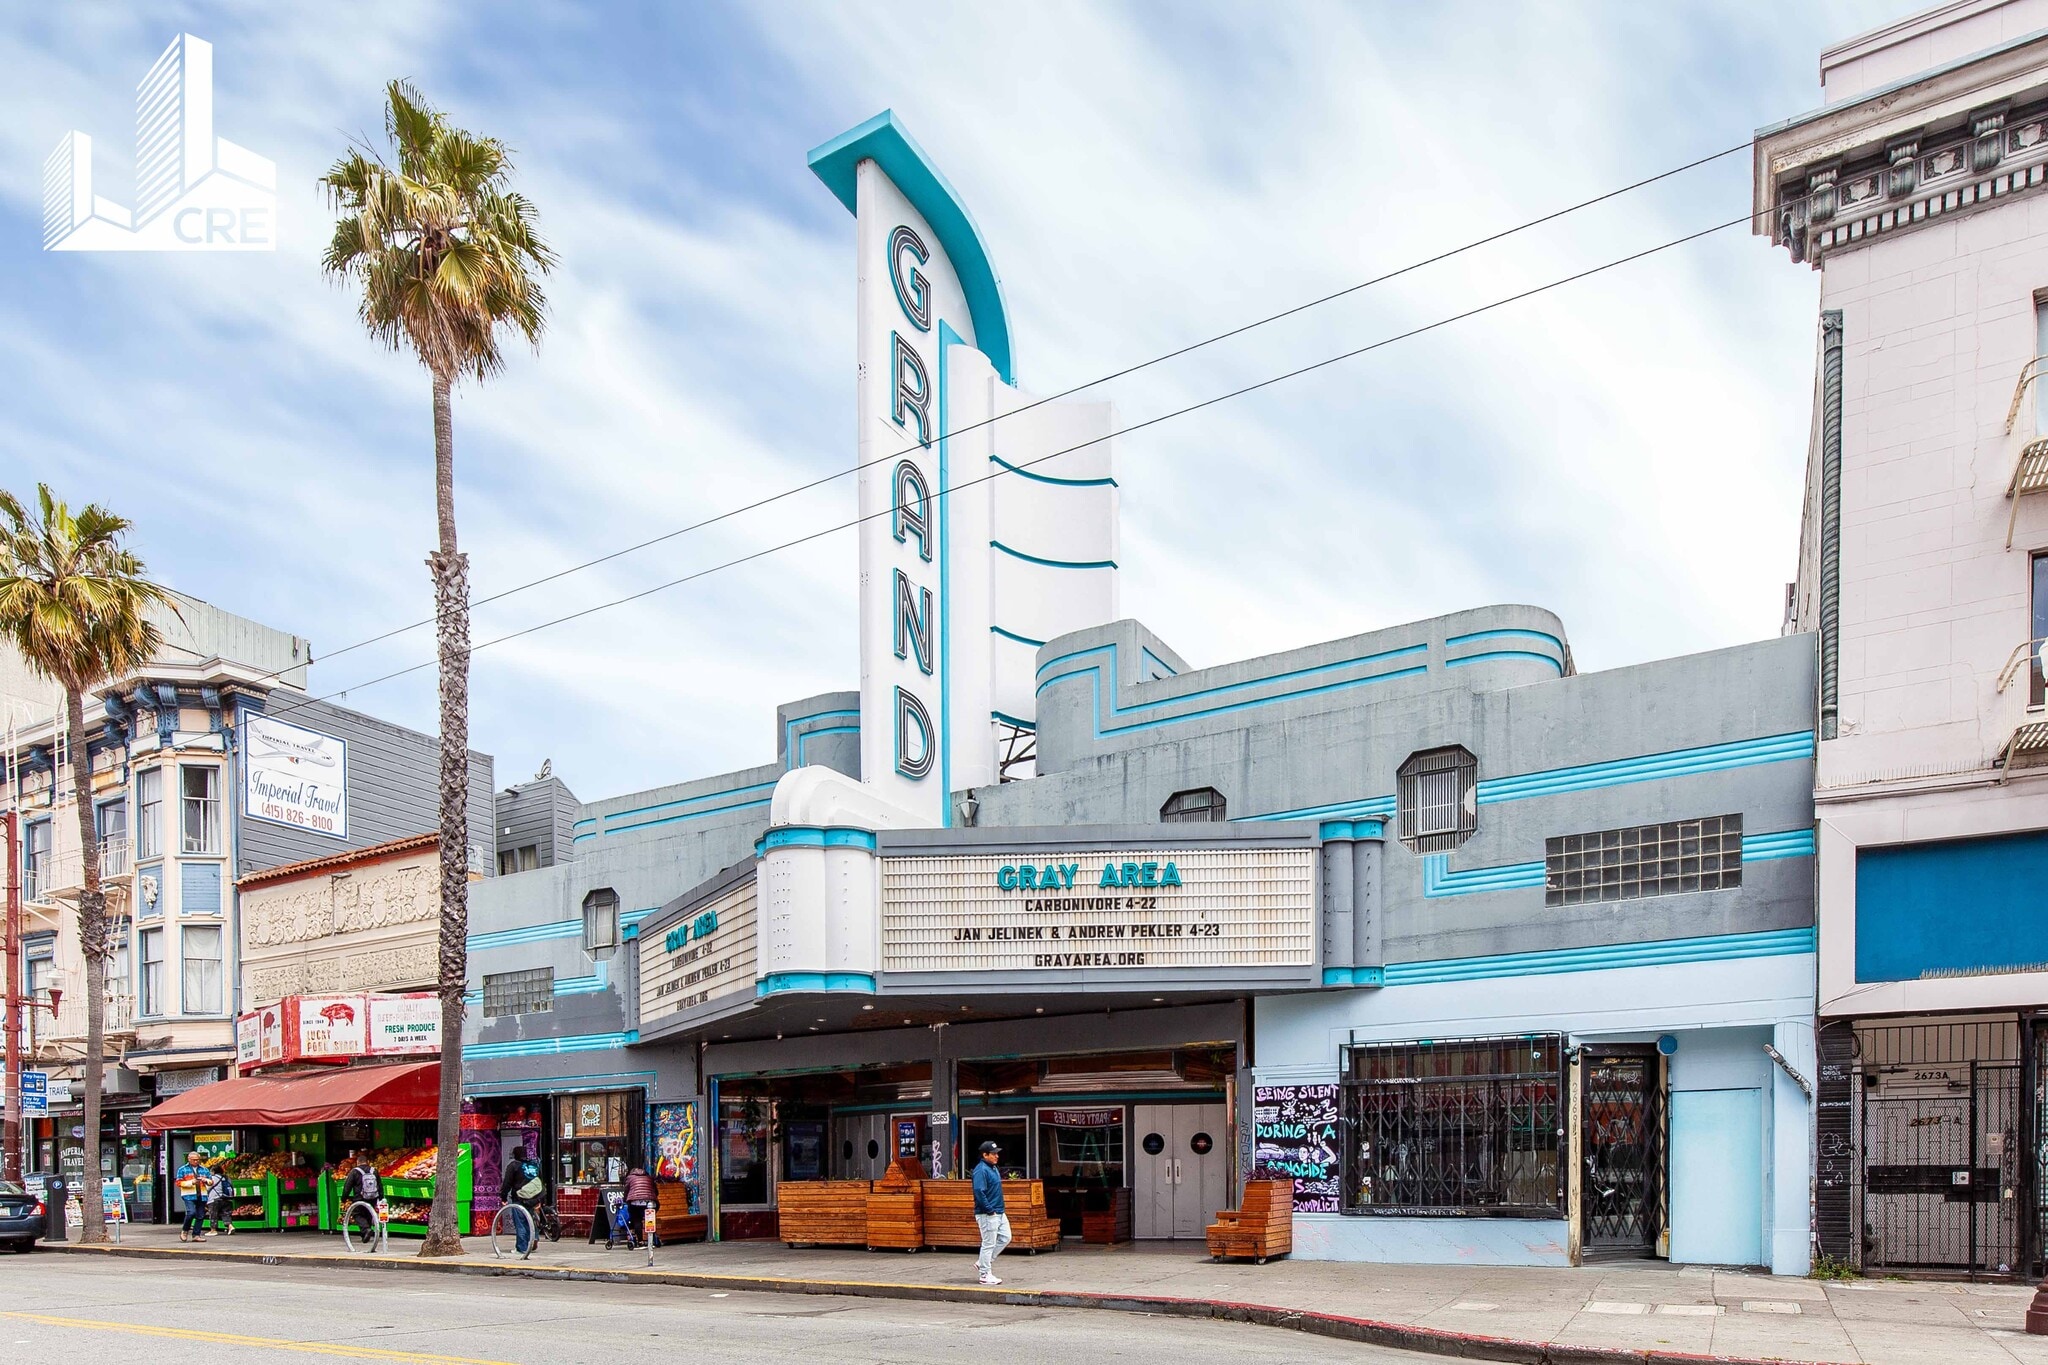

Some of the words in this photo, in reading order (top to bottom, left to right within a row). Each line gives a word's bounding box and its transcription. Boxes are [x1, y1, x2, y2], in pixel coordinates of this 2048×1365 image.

[888, 225, 935, 780] GRAND
[250, 770, 304, 805] Imperial
[305, 784, 342, 815] Travel
[261, 802, 284, 819] (415)
[998, 865, 1079, 891] GRAY
[1100, 862, 1182, 888] AREA
[1025, 897, 1121, 912] CARBONIVORE
[1125, 897, 1157, 910] 4-22
[665, 924, 688, 954] GRAY
[692, 910, 719, 941] AREA
[954, 928, 981, 940] JAN
[988, 927, 1043, 940] JELINEK
[1051, 926, 1061, 939] &
[1068, 925, 1125, 939] ANDREW
[1131, 924, 1182, 938] PEKLER
[1190, 923, 1220, 937] 4-23
[1035, 953, 1145, 967] GRAYAREA.ORG
[307, 1030, 331, 1041] LUCKY
[384, 1025, 405, 1034] FRESH
[407, 1023, 436, 1033] PRODUCE
[164, 1073, 176, 1089] SF
[177, 1070, 210, 1088] SOCCER
[1914, 1072, 1949, 1080] 2673A
[1256, 1086, 1296, 1102] BEING
[1298, 1084, 1340, 1100] SILENT
[581, 1104, 601, 1115] GRAND
[581, 1115, 601, 1127] COFFEE
[932, 1114, 948, 1123] 2665
[1256, 1121, 1307, 1140] DURING
[1322, 1124, 1336, 1140] A
[60, 1146, 85, 1160] IMPERIA
[607, 1191, 625, 1204] GRAN
